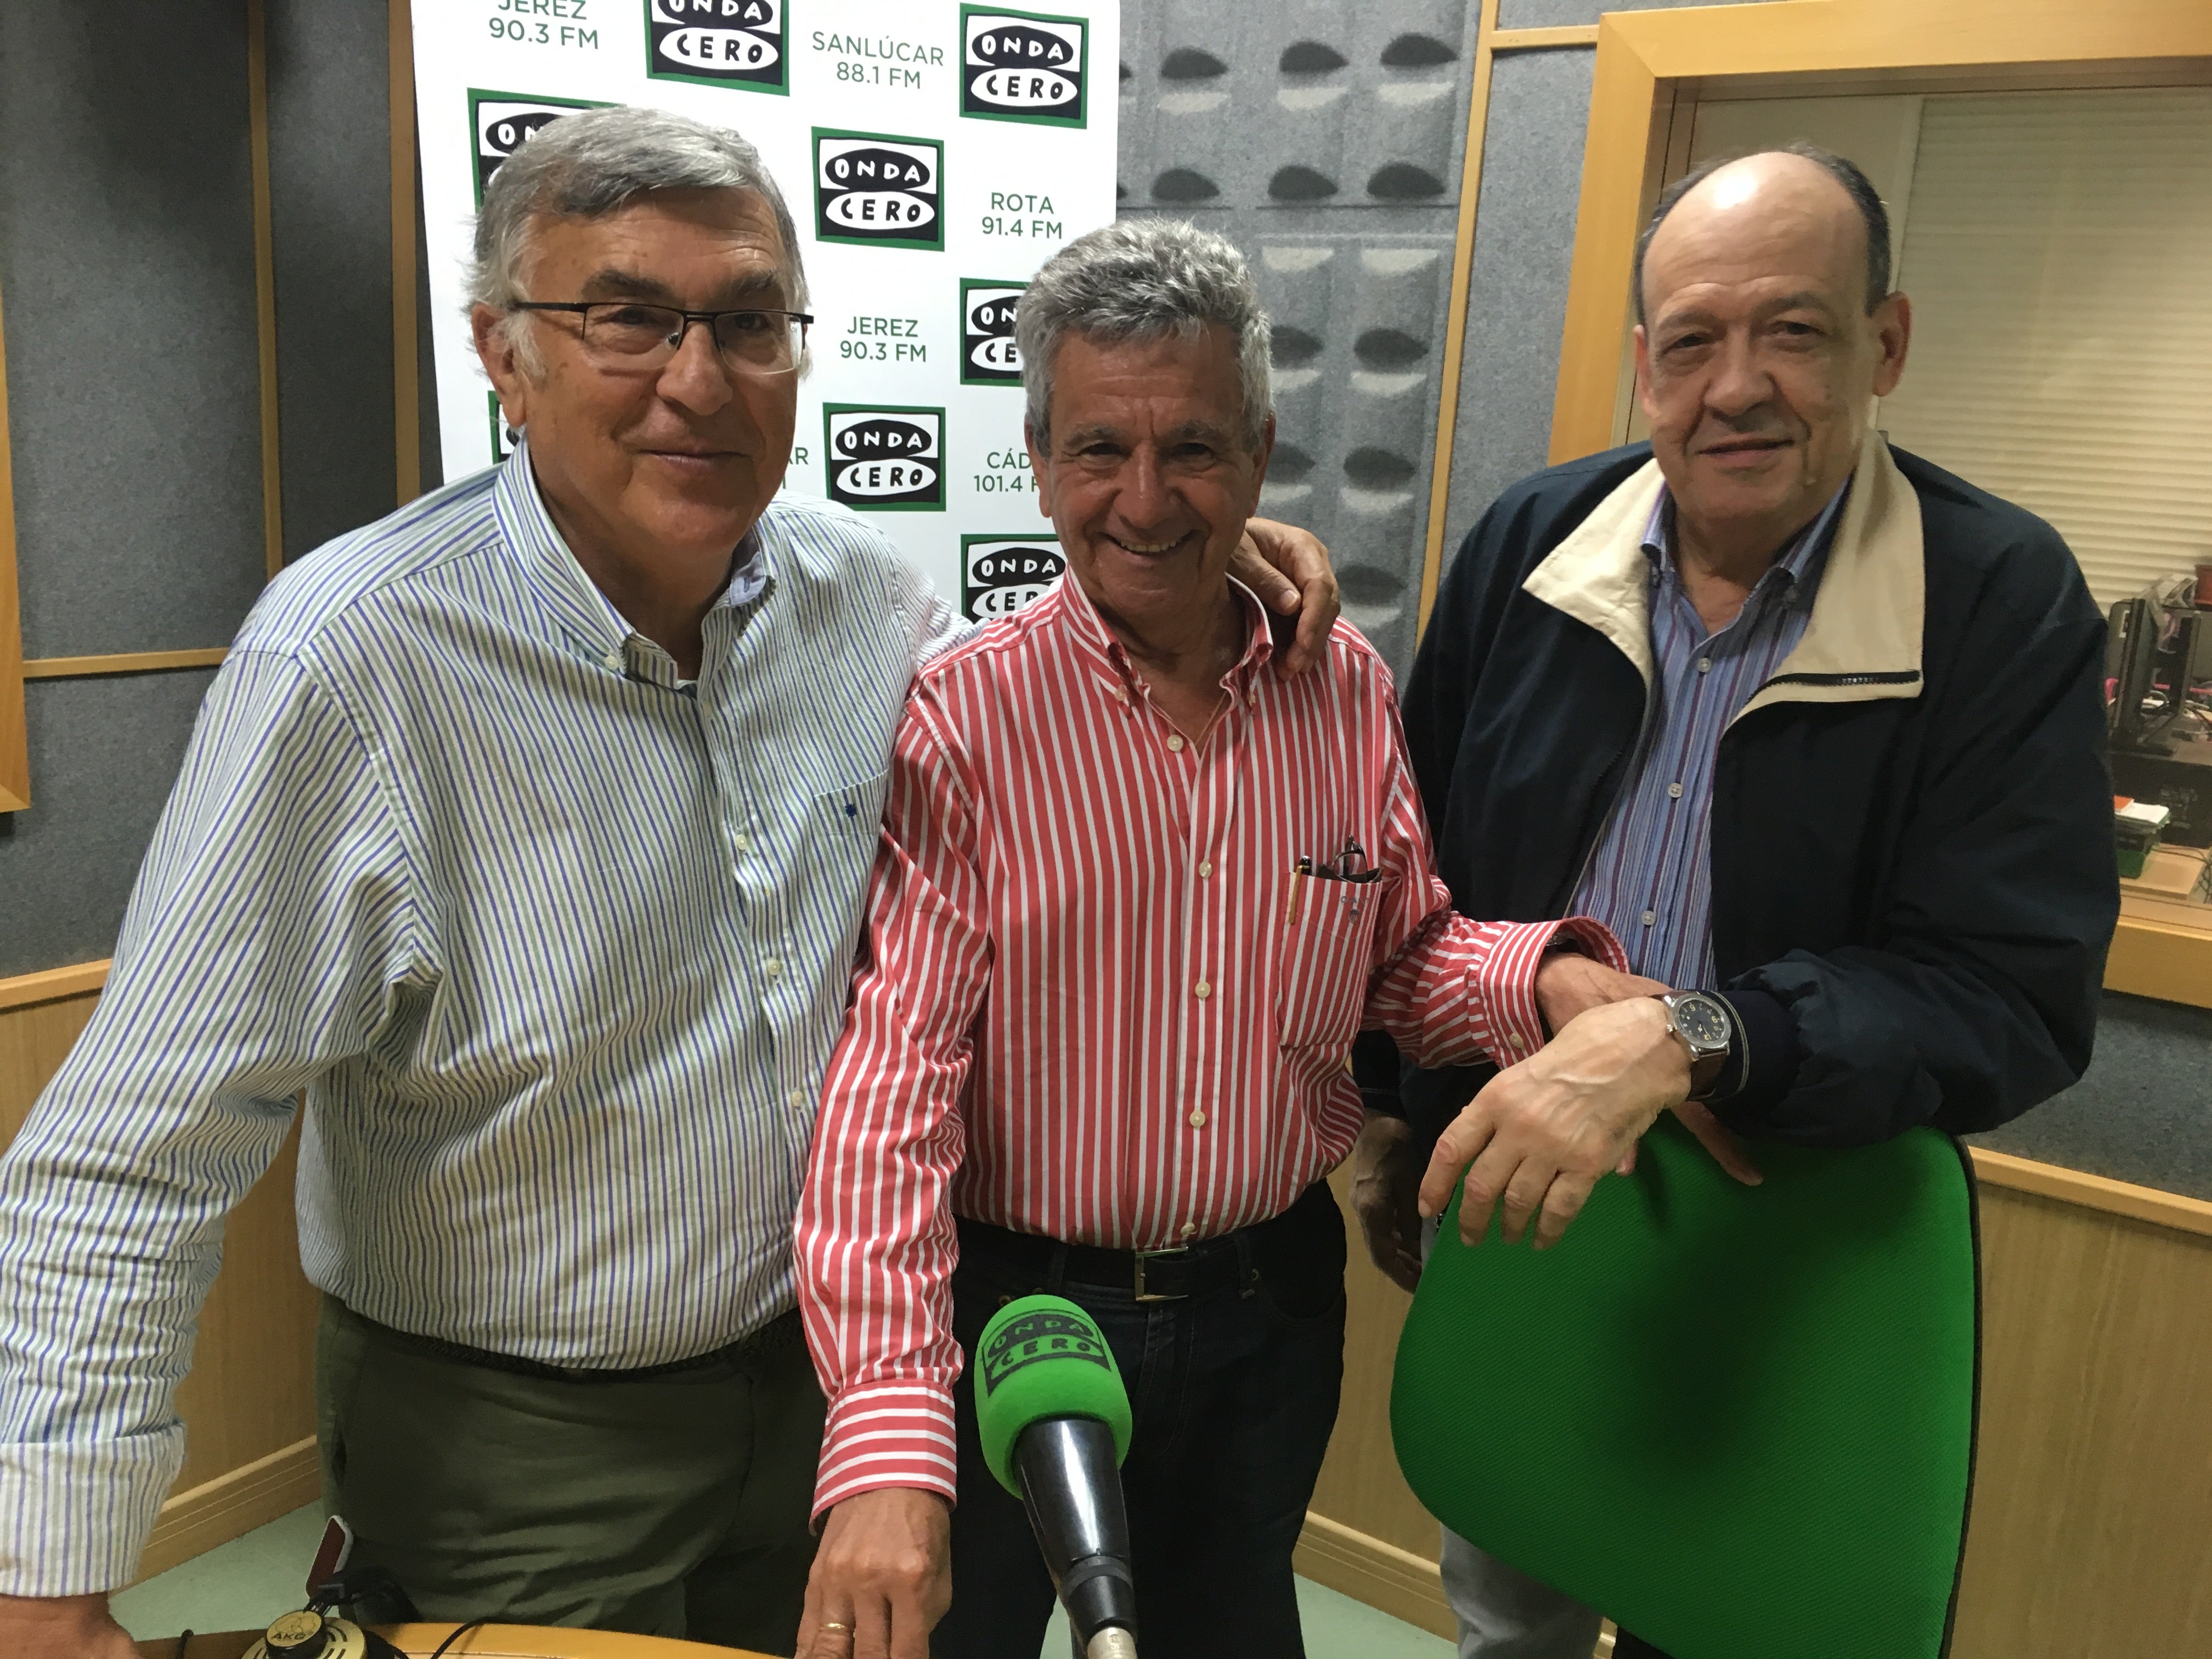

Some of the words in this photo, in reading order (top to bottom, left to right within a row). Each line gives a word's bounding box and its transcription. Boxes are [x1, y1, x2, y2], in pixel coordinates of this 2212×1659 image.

[668, 0, 762, 20] ONDA
[489, 18, 549, 44] 90.3
[561, 26, 598, 49] FM
[676, 33, 763, 63] CERO
[812, 31, 944, 66] SANLÚCAR
[981, 35, 1064, 61] ONDA
[837, 61, 879, 84] 88.1
[890, 68, 920, 89] FM
[986, 74, 1063, 100] CERO
[834, 158, 921, 182] ONDA
[840, 198, 921, 222] CERO
[991, 192, 1054, 214] ROTA
[982, 216, 1023, 236] 91.4
[1032, 220, 1062, 239] FM
[847, 317, 918, 337] JEREZ
[981, 307, 1018, 325] ON
[840, 340, 887, 360] 90.3
[896, 343, 926, 362] FM
[985, 342, 1017, 363] CE
[844, 431, 922, 449] ONDA
[987, 447, 1032, 469] CÁD
[850, 466, 923, 488] CERO
[974, 475, 1023, 492] 101.4
[981, 558, 1057, 577] ONDA
[994, 1320, 1084, 1349] ONDA
[1001, 1338, 1091, 1366] CERO
